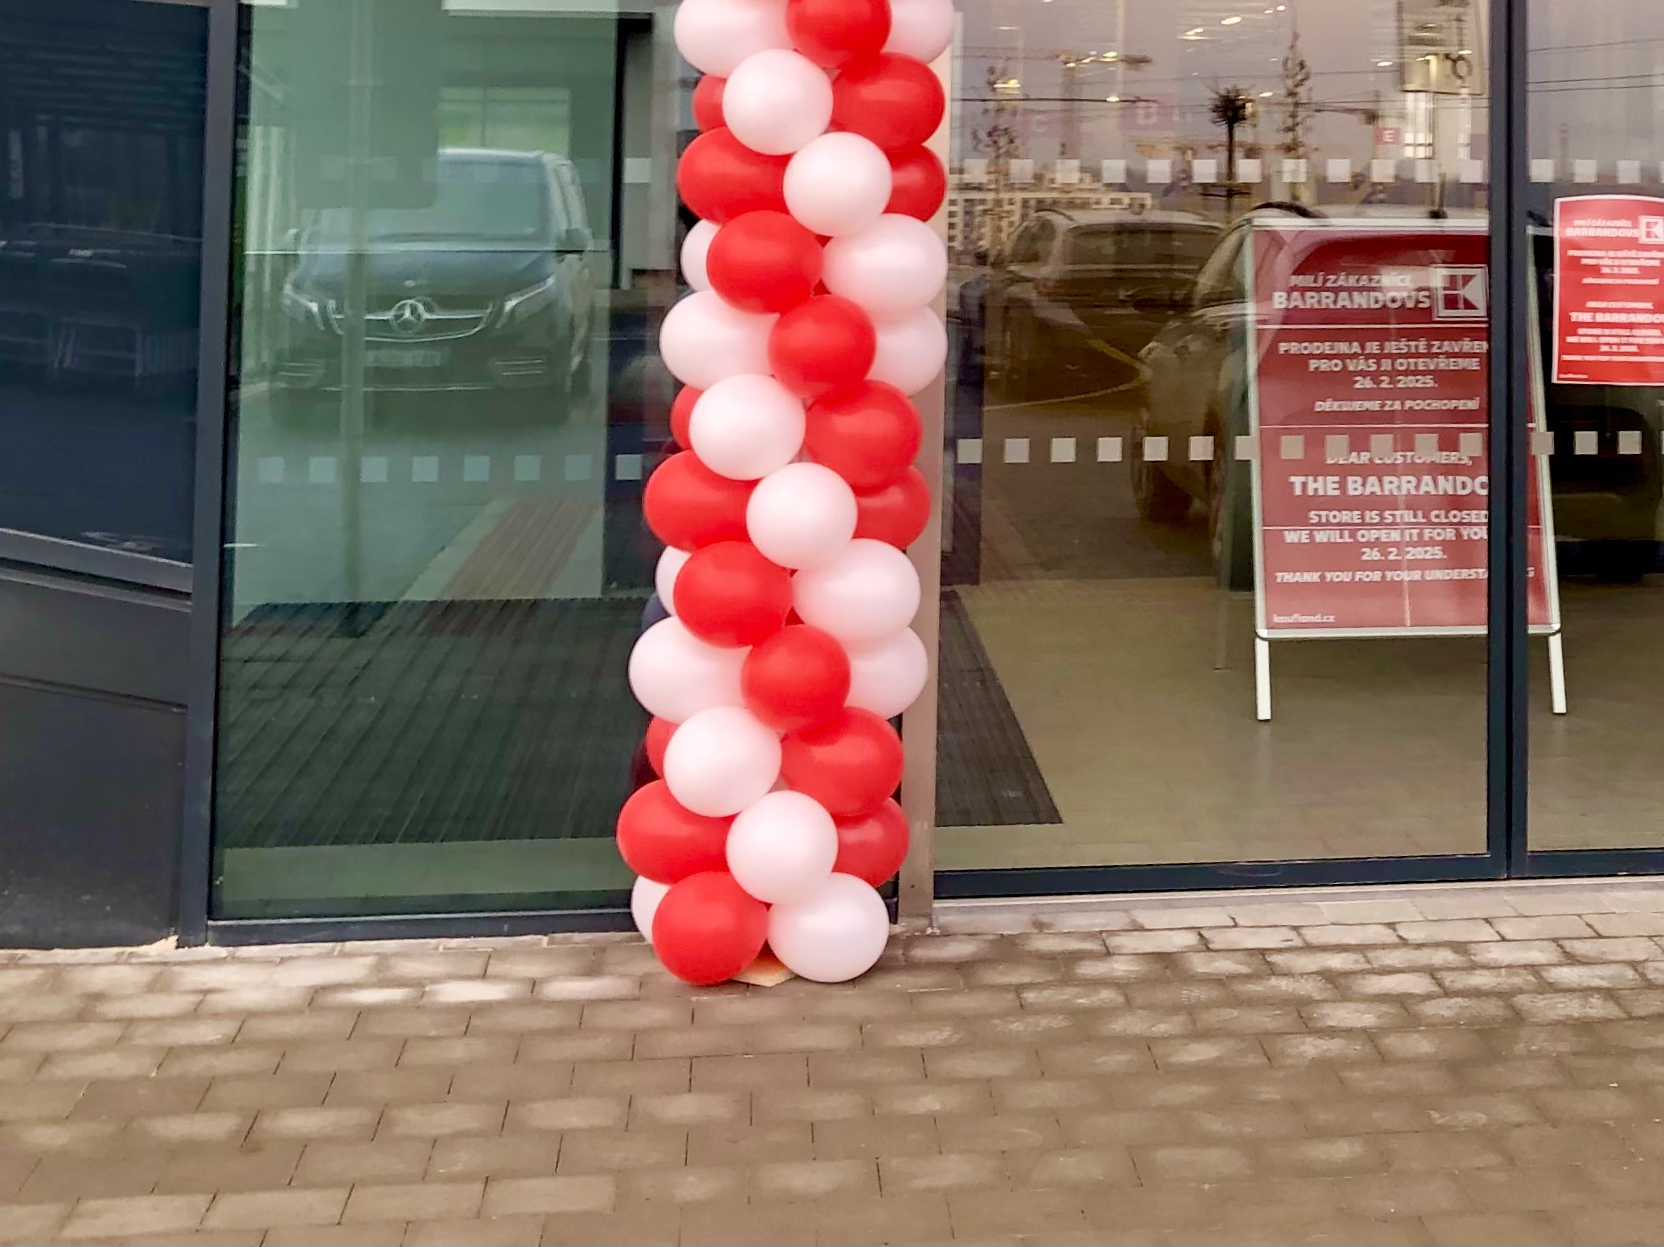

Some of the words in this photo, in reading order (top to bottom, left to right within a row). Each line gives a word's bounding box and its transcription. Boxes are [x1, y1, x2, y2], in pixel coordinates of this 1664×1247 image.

[1308, 359, 1343, 371] PRO
[1346, 356, 1377, 371] VÁS
[1395, 355, 1480, 370] OTEVŘEME
[1353, 376, 1377, 388] 26.
[1379, 376, 1394, 388] 2.
[1396, 375, 1438, 388] 2025.
[1380, 399, 1402, 411] ZA
[1289, 476, 1341, 496] THE
[1346, 475, 1488, 496] BARRANDO
[1308, 510, 1362, 523] STORE
[1365, 510, 1381, 523] IS
[1383, 510, 1426, 523] STILL
[1430, 509, 1488, 523] CLOSED
[1283, 530, 1310, 543] WE
[1313, 530, 1353, 543] WILL
[1357, 529, 1401, 542] OPEN
[1404, 529, 1420, 542] IT
[1423, 528, 1456, 541] FOR
[1361, 547, 1385, 560] 26.
[1387, 548, 1402, 560] 2.
[1404, 547, 1447, 560] 2025.
[1275, 571, 1321, 583] THANK
[1324, 571, 1352, 582] YOU
[1354, 570, 1382, 582] FOR
[1384, 570, 1422, 582] YOUR
